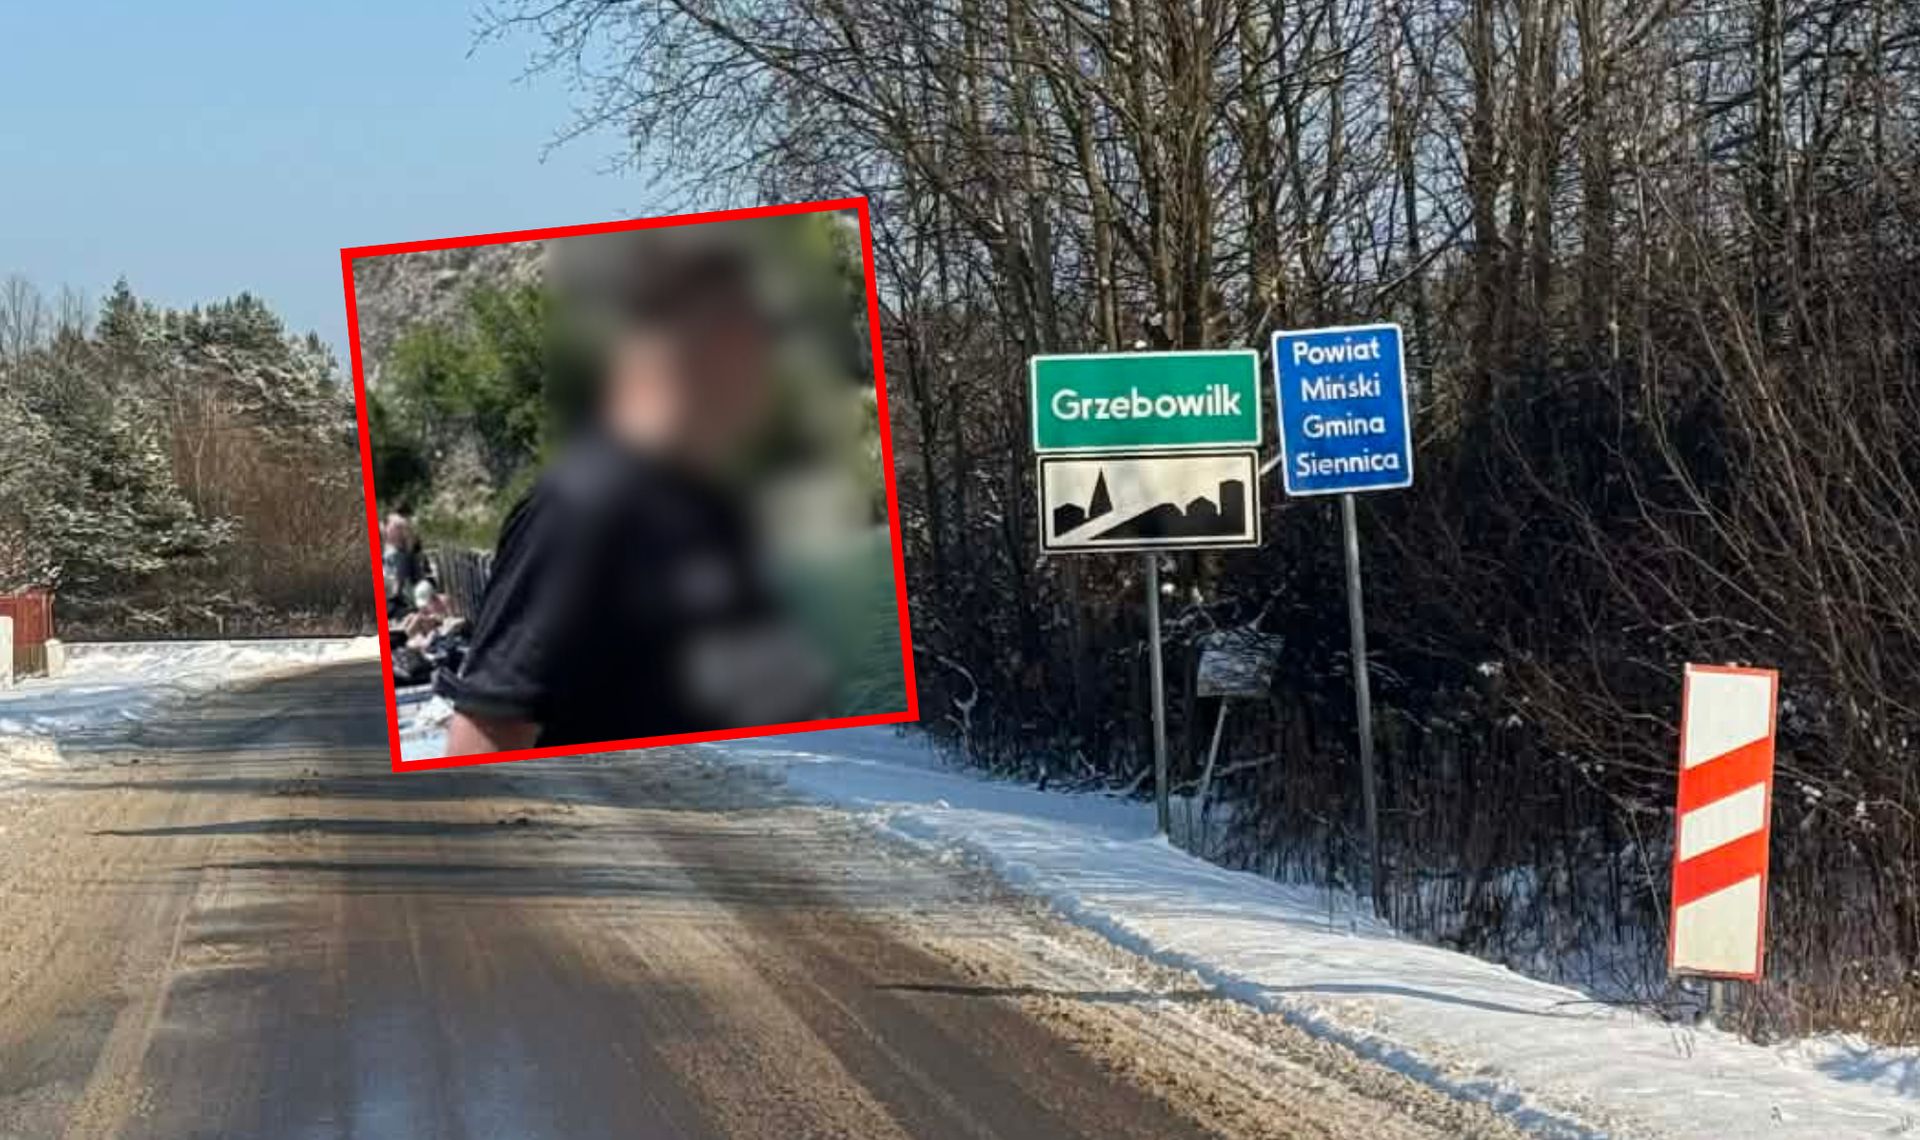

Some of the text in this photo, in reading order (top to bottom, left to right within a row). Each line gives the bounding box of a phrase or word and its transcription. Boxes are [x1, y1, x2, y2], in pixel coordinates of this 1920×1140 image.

[1292, 336, 1381, 366] Powiat
[1051, 384, 1242, 420] Grzebowilk
[1301, 372, 1381, 402] Miński
[1302, 411, 1386, 438] Gmina
[1296, 447, 1400, 478] Siennica
